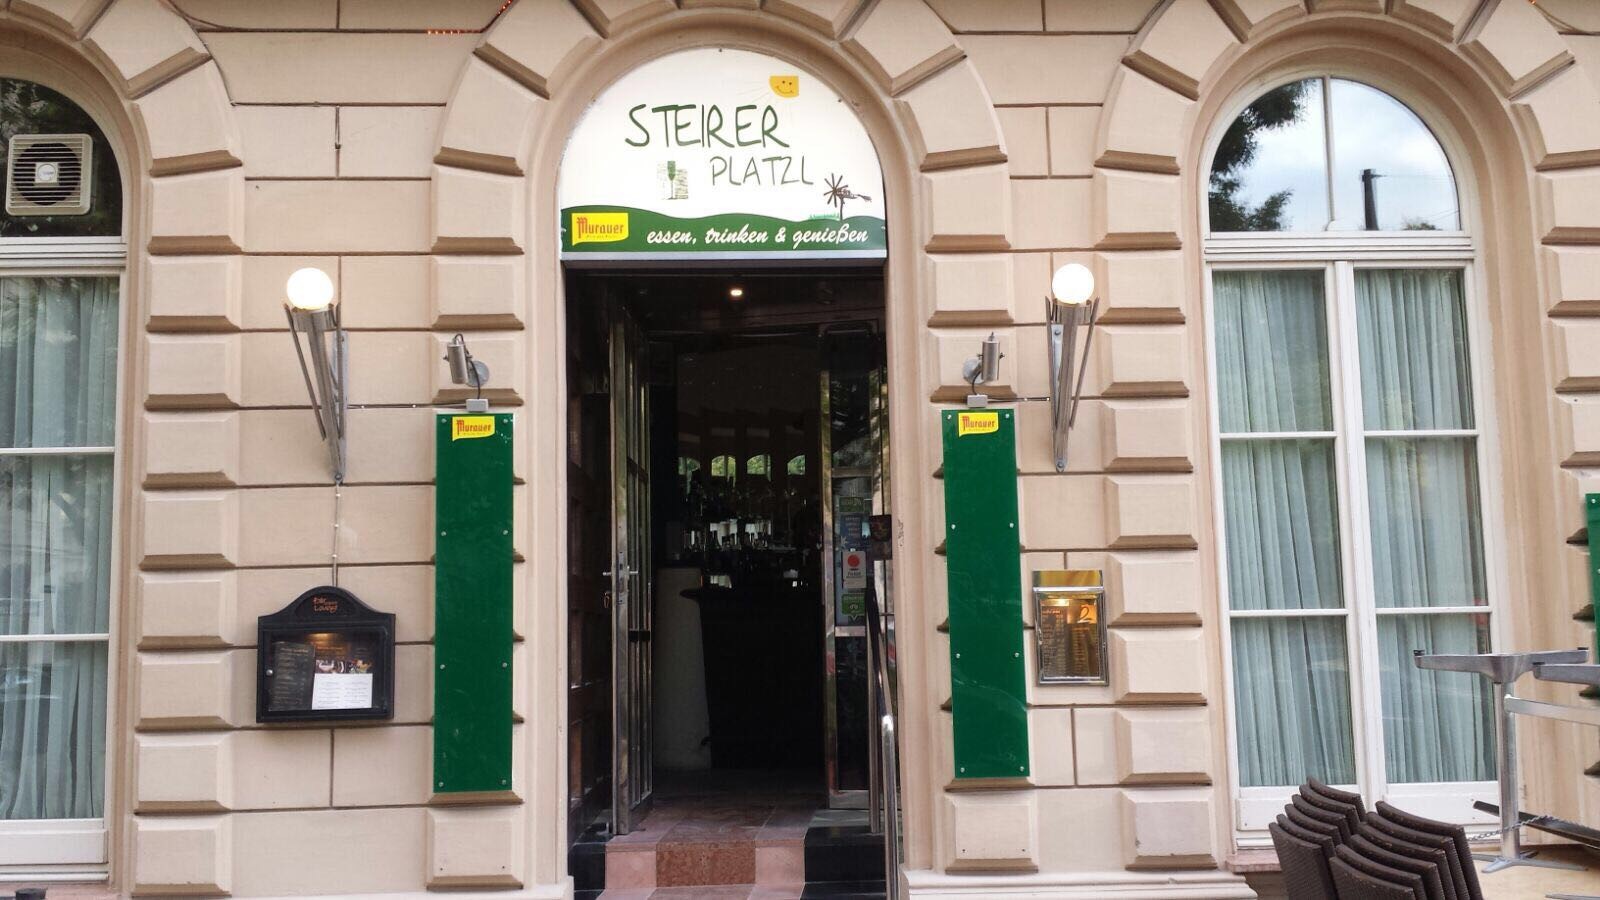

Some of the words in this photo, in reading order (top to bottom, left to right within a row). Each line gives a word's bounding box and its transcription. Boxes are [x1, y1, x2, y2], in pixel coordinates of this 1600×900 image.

[625, 103, 790, 149] STEIRER
[710, 156, 814, 186] PLATZL
[576, 217, 625, 240] Murauer
[646, 229, 697, 246] essen,
[705, 223, 769, 244] trinken
[775, 227, 786, 242] &
[792, 223, 869, 250] genießen
[456, 419, 492, 436] Murauer
[962, 415, 995, 432] Murauer
